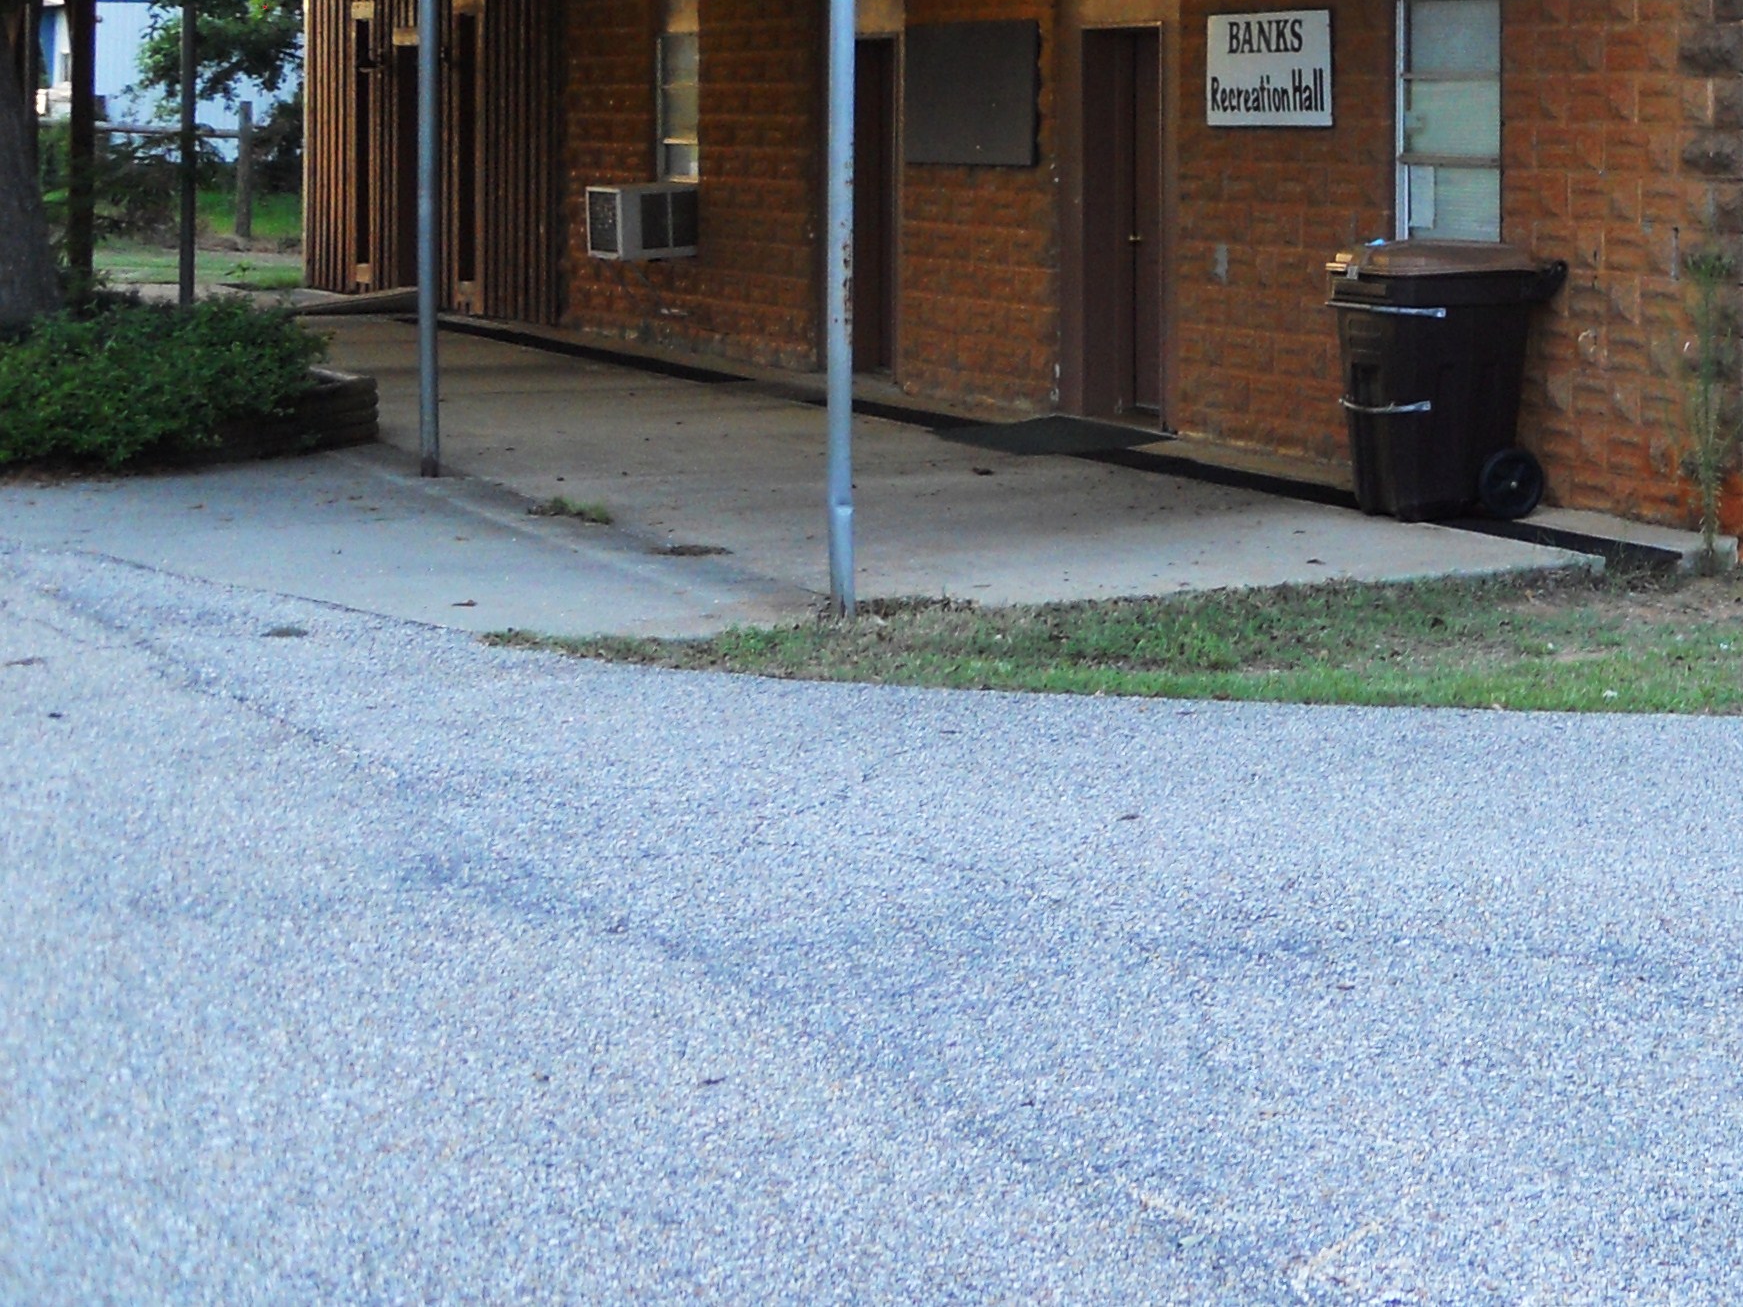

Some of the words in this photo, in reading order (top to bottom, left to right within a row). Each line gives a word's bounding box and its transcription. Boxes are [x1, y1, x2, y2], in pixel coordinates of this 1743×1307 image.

[1227, 19, 1303, 54] BANKS
[1211, 75, 1291, 112] Recreation
[1291, 68, 1325, 112] Hall
